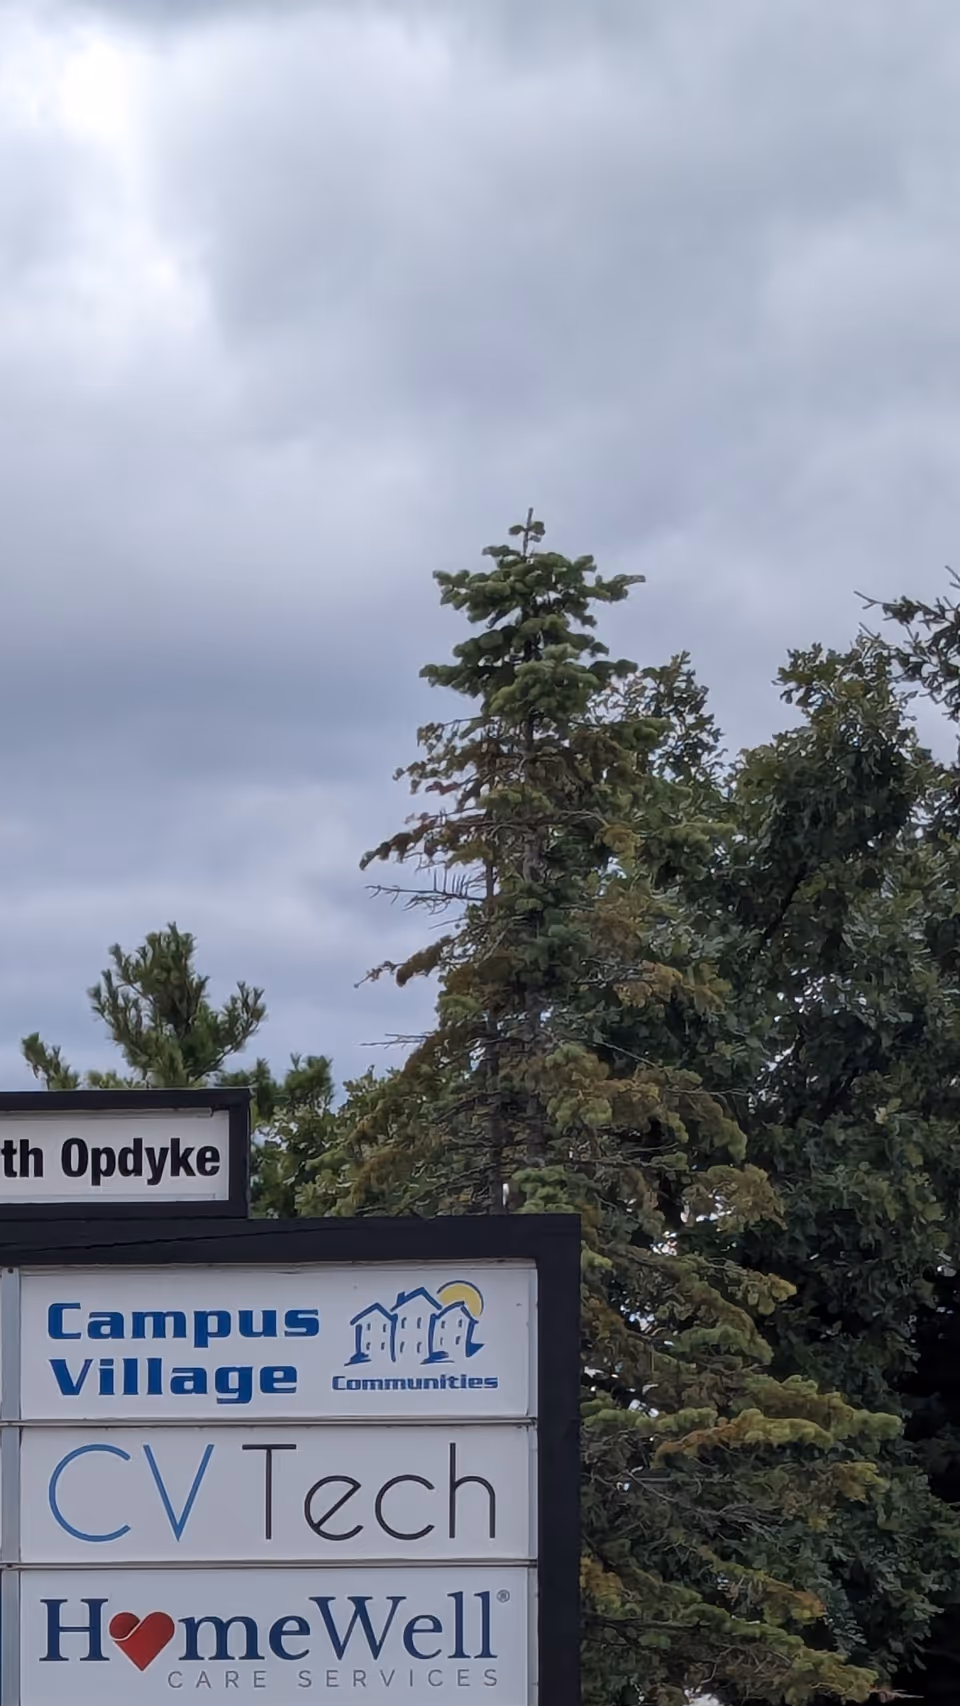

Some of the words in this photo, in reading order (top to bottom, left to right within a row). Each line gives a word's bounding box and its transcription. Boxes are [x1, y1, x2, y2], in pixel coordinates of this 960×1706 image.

[61, 1138, 220, 1186] Opdyke
[48, 1303, 319, 1348] Campus
[49, 1358, 297, 1404] Village
[333, 1374, 498, 1390] Communities
[168, 1671, 266, 1688] CARE
[298, 1669, 497, 1687] SERVICES
